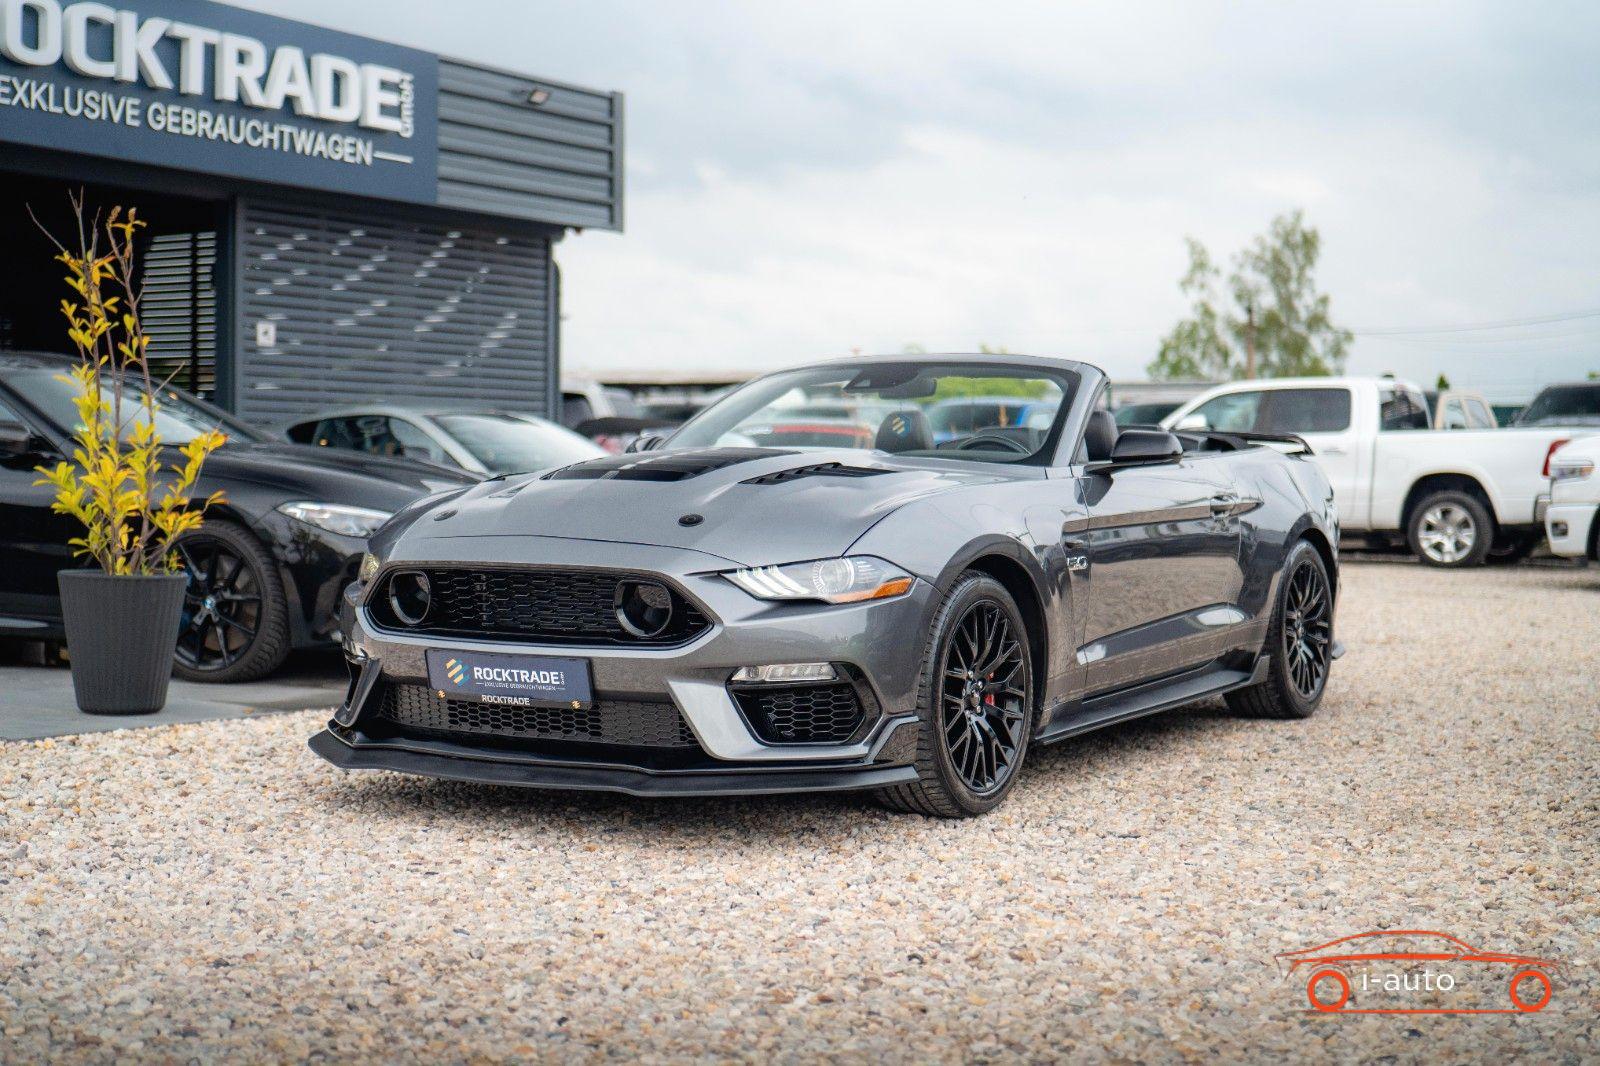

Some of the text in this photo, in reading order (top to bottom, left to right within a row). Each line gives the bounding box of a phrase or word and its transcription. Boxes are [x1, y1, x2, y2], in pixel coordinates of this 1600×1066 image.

[0, 74, 373, 166] EXKLUSIVE GEBRAUCHTWAGEN
[473, 667, 560, 685] ROCKTRADE
[481, 694, 530, 706] ROCKTRADE
